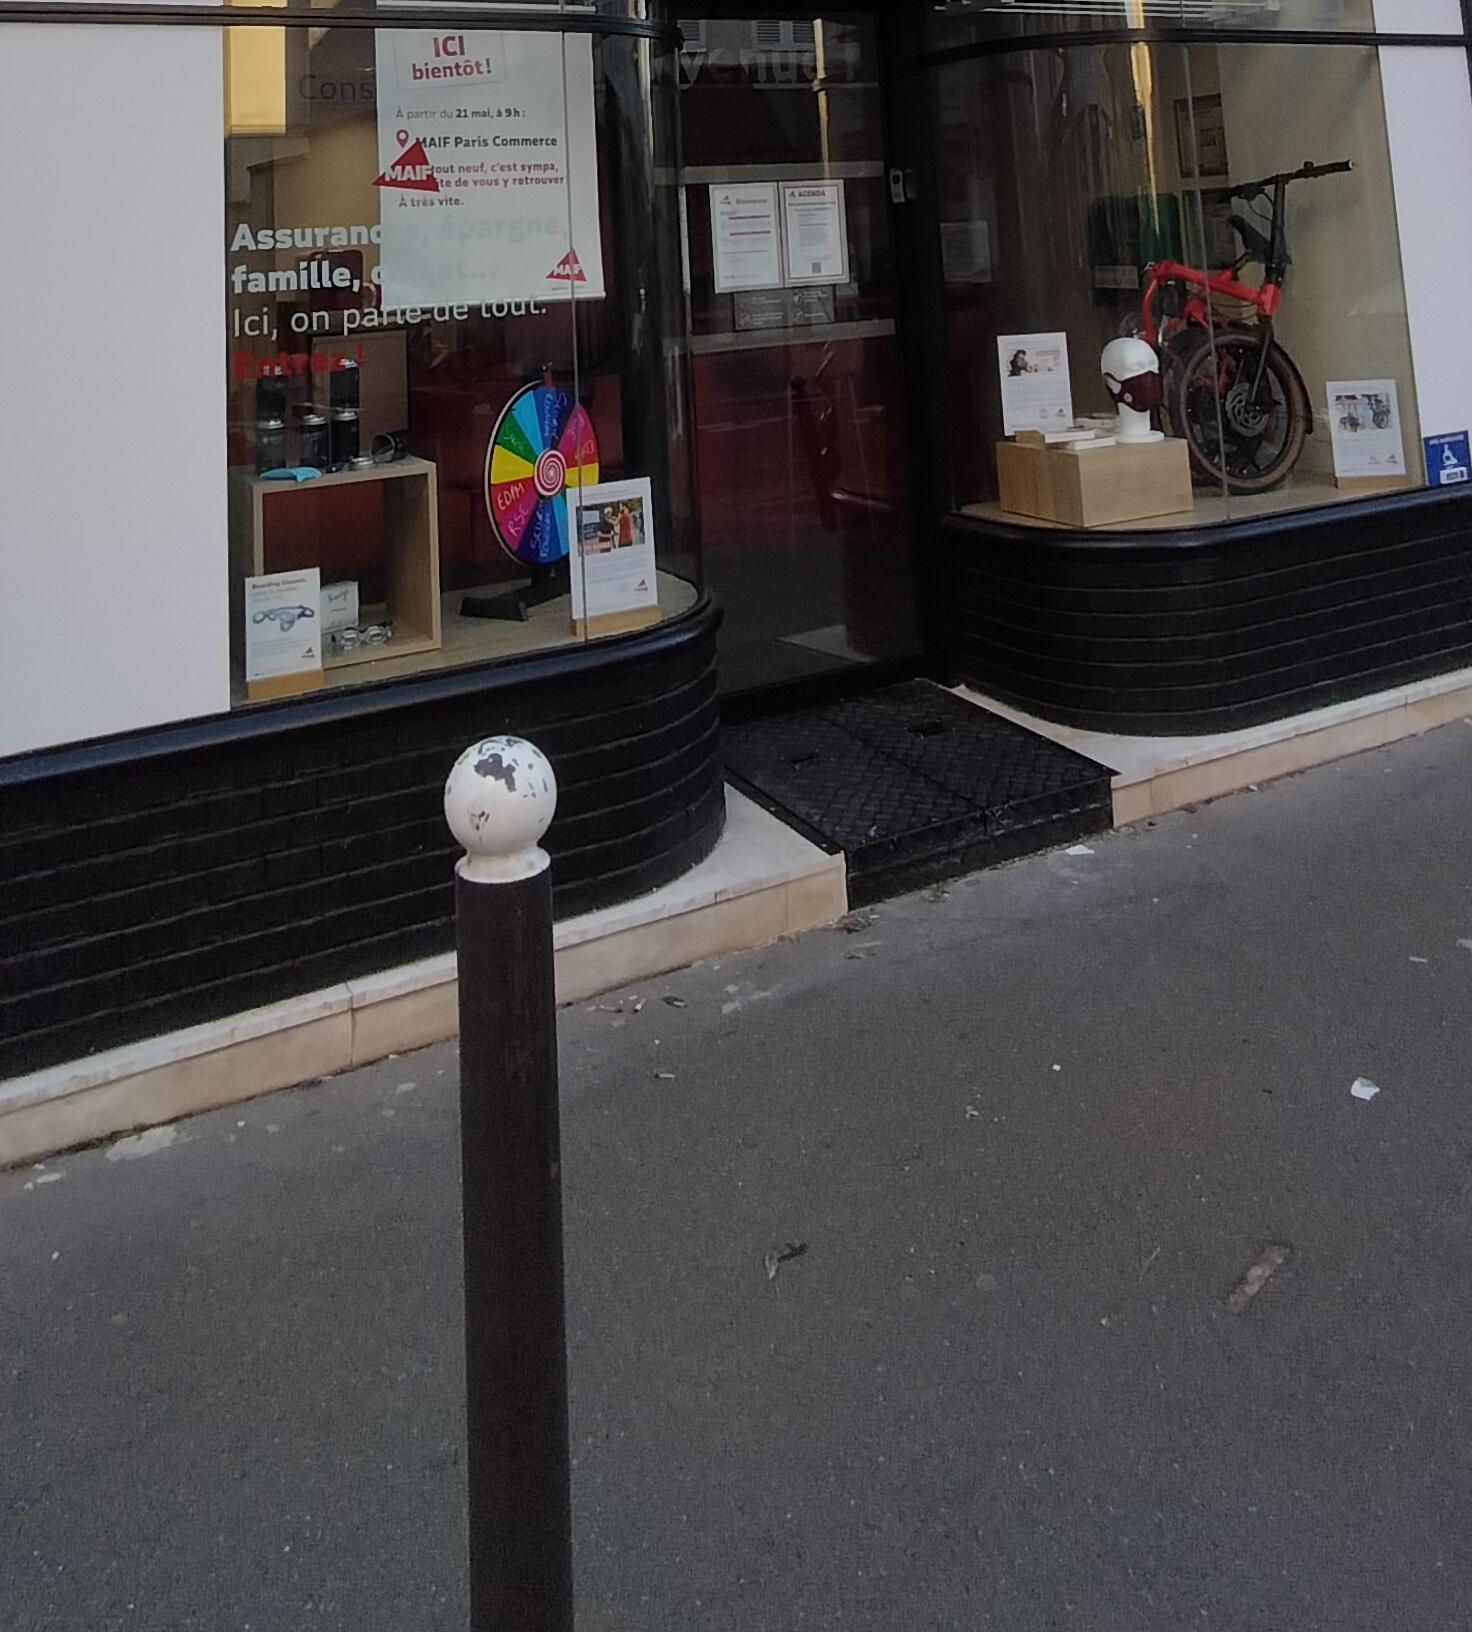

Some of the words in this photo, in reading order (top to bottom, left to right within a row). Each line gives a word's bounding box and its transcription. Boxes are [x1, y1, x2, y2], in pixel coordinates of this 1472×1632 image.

[432, 35, 466, 58] ICI
[407, 109, 436, 121] partir
[440, 109, 454, 119] du
[456, 109, 469, 119] 21
[471, 108, 494, 120] mai,
[454, 136, 489, 148] Paris
[492, 135, 558, 148] Commerce
[383, 164, 434, 182] MAIF
[458, 164, 487, 175] neuf,
[521, 163, 559, 175] sympa,
[455, 177, 469, 188] de
[472, 178, 499, 187] vous
[503, 178, 509, 188] y
[513, 176, 564, 186] retrouver
[410, 196, 435, 208] très
[438, 195, 464, 207] vite.
[231, 259, 361, 294] famille,
[234, 307, 278, 341] Ici,
[291, 310, 330, 333] on
